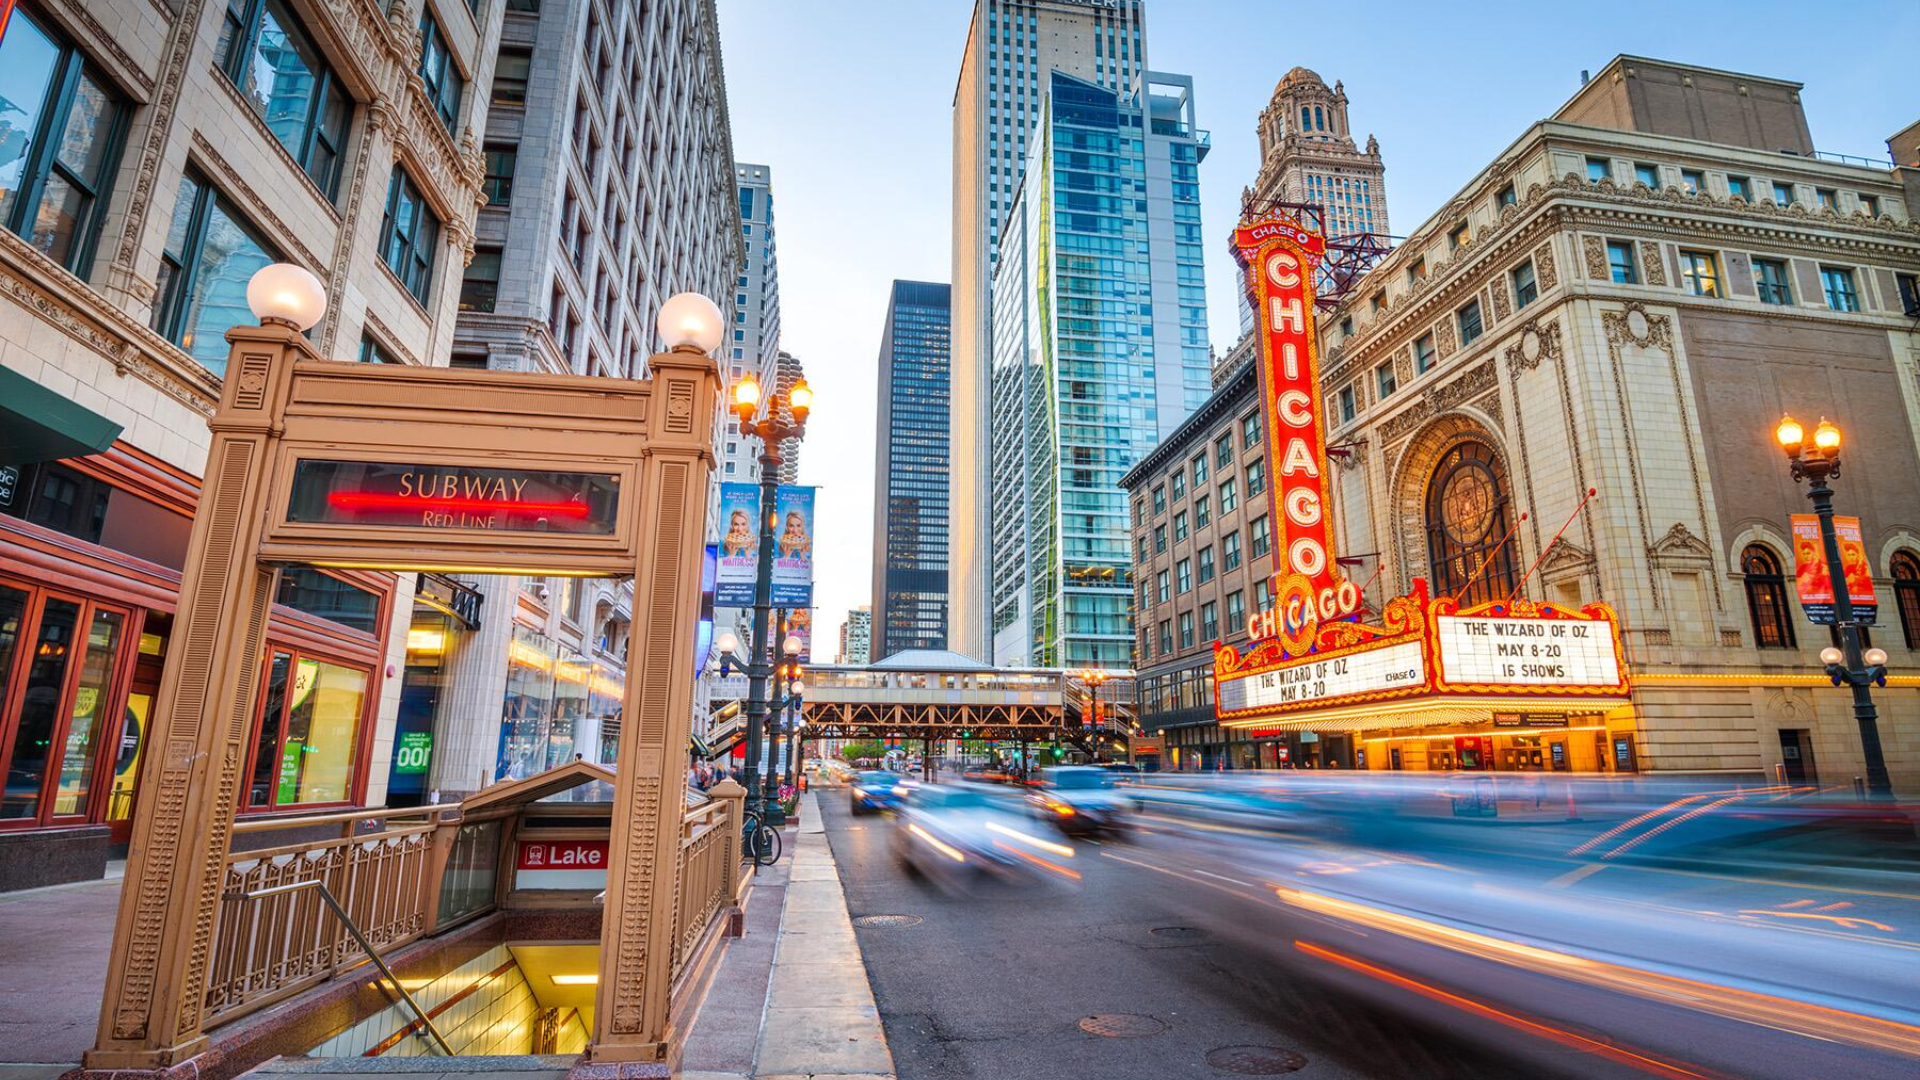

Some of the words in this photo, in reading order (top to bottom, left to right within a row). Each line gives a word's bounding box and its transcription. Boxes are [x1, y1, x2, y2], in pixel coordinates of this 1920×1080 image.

[1252, 226, 1296, 240] CHASE
[1265, 252, 1327, 578] CHICAGO
[398, 472, 529, 502] SUBWAY
[722, 557, 754, 568] WAITRESS
[1248, 581, 1358, 641] CHICAGO
[1464, 622, 1490, 636] THE
[1494, 622, 1545, 638] WIZARD
[1551, 624, 1568, 637] OF
[1572, 625, 1589, 639] OZ
[1498, 643, 1527, 657] MAY
[1531, 644, 1561, 658] 8-20
[1261, 674, 1275, 689] THE
[1279, 664, 1311, 686] WIZARD
[1316, 661, 1328, 679] OF
[1333, 658, 1348, 675] OZ
[1385, 671, 1408, 683] CHASE
[1502, 663, 1517, 677] 16
[1521, 664, 1565, 678] SHOWS
[1280, 686, 1298, 701] MAY
[1301, 682, 1326, 699] 8-20
[549, 846, 602, 865] Lake
